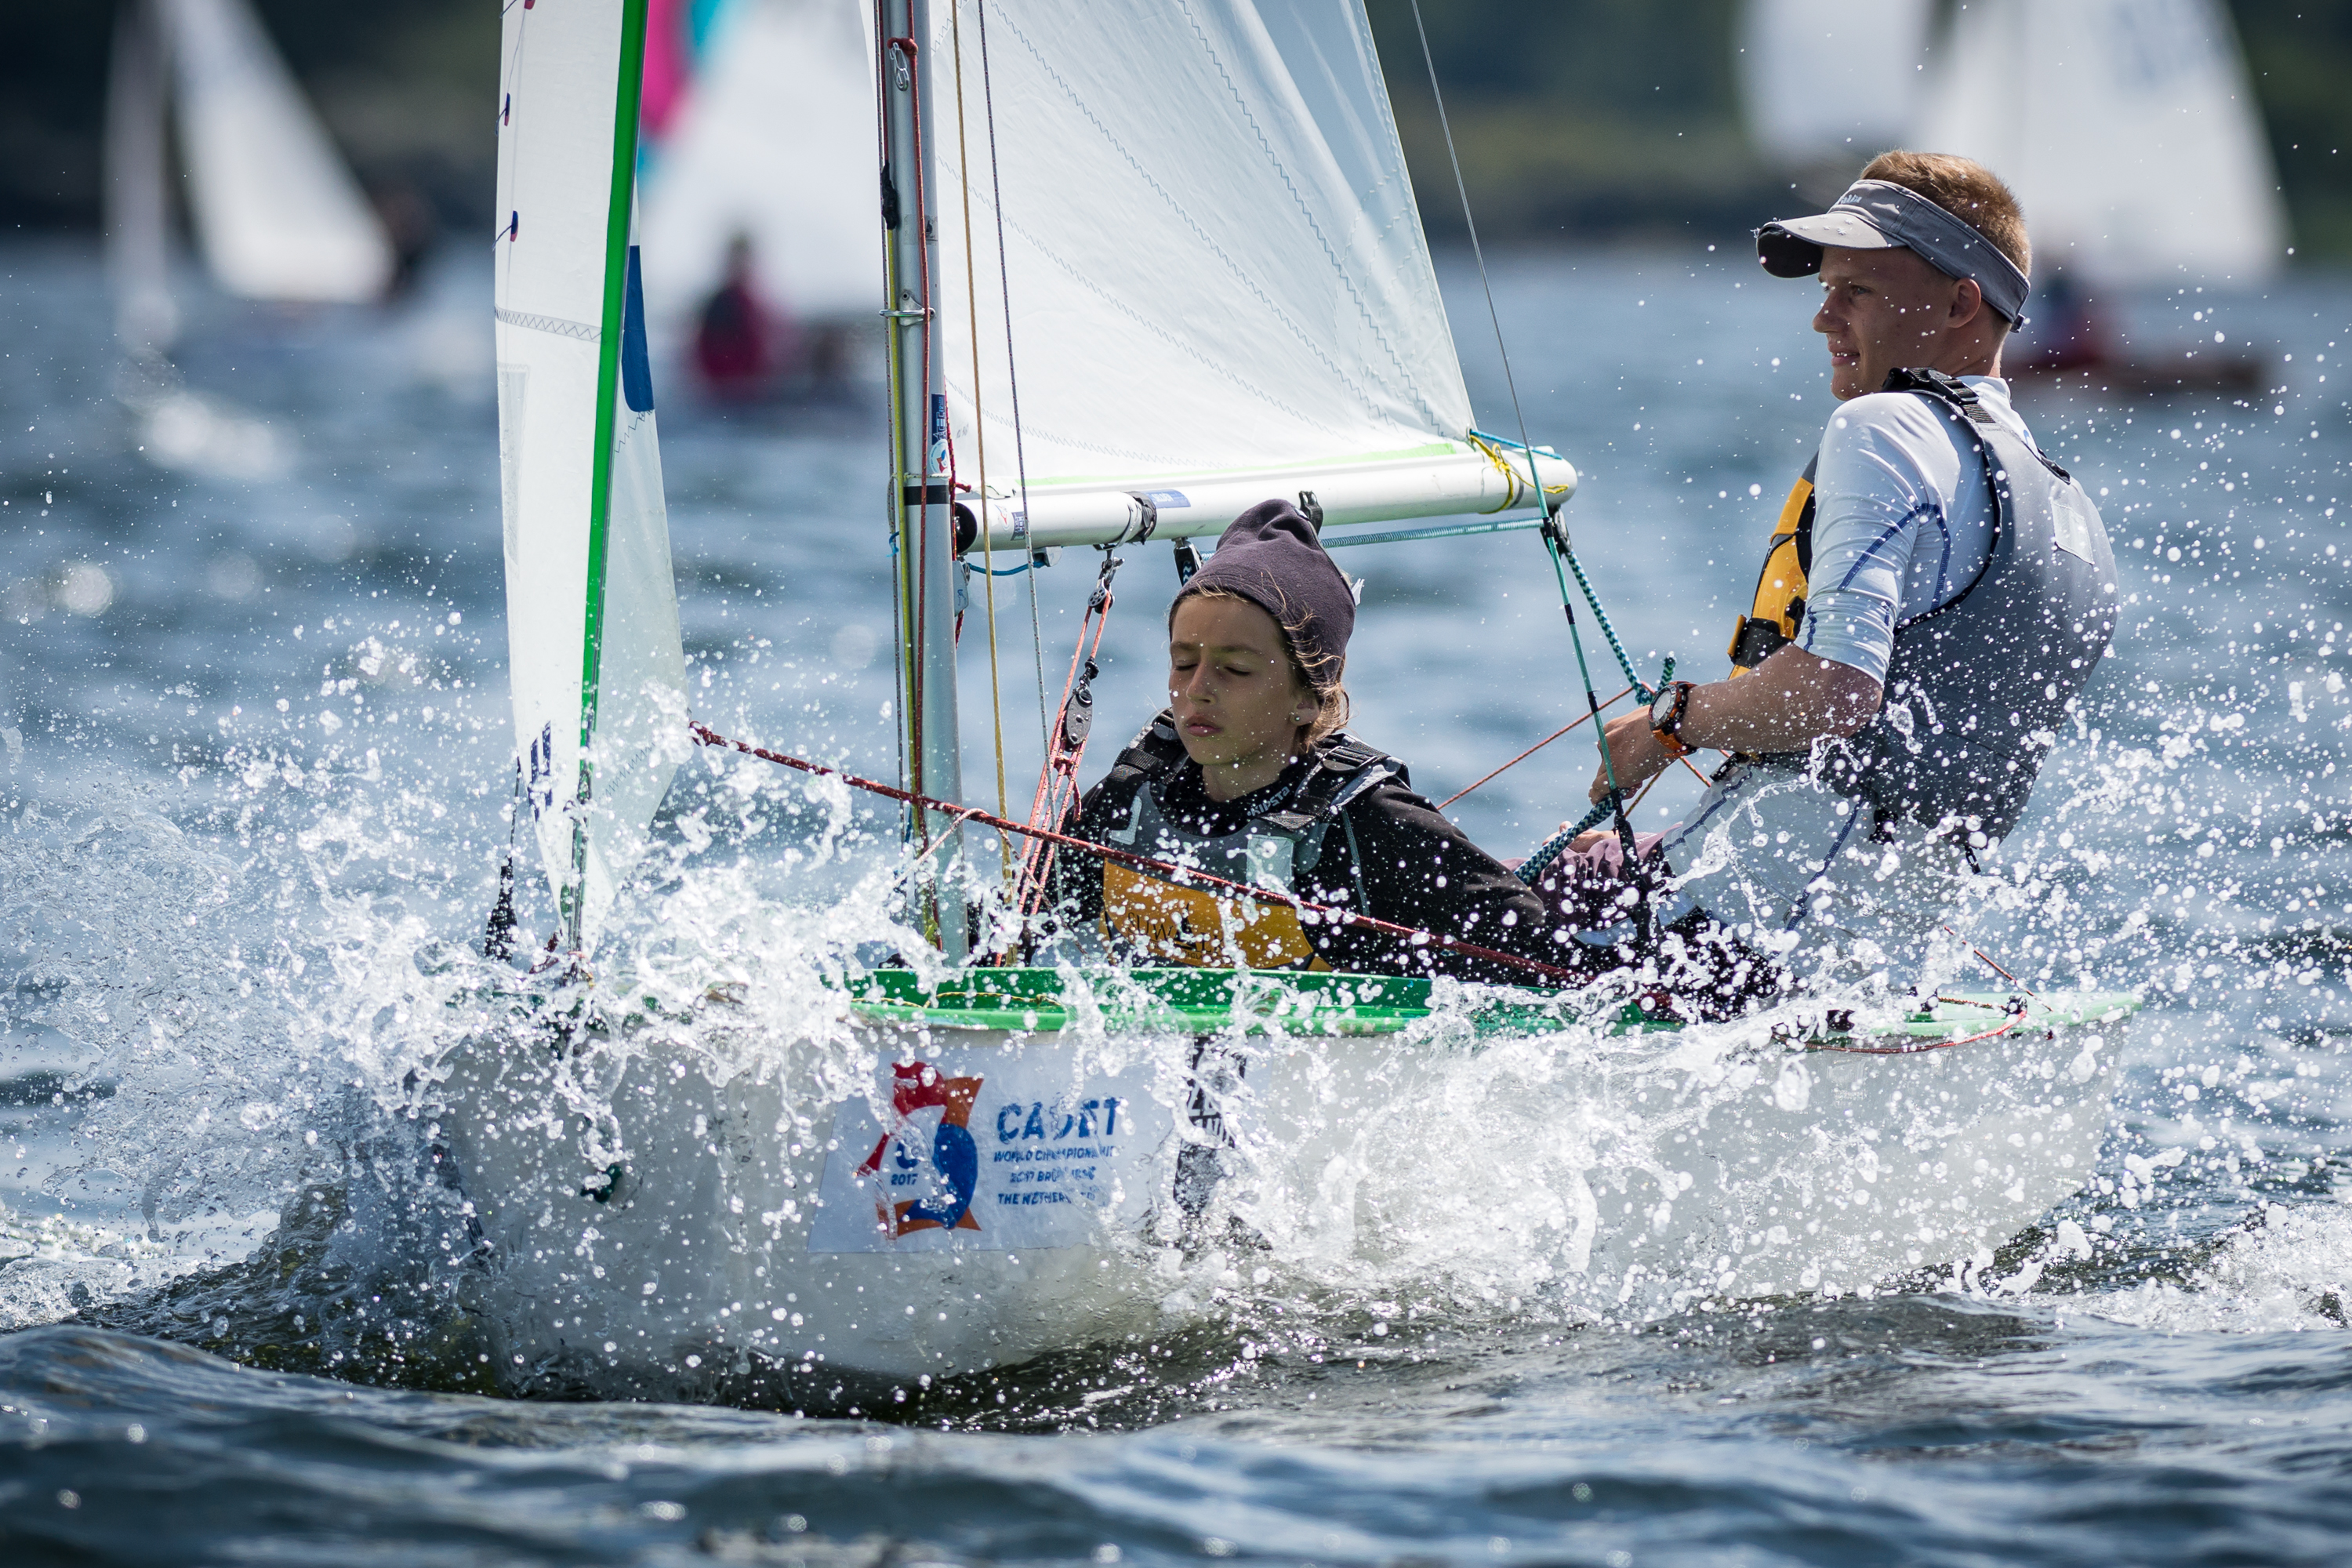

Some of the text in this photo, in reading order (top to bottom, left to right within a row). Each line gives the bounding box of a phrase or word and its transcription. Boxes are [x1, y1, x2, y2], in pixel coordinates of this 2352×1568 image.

[997, 1097, 1120, 1142] CADET
[993, 1149, 1033, 1163] WORLD
[891, 1173, 918, 1185] 2017
[997, 1193, 1020, 1204] THE
